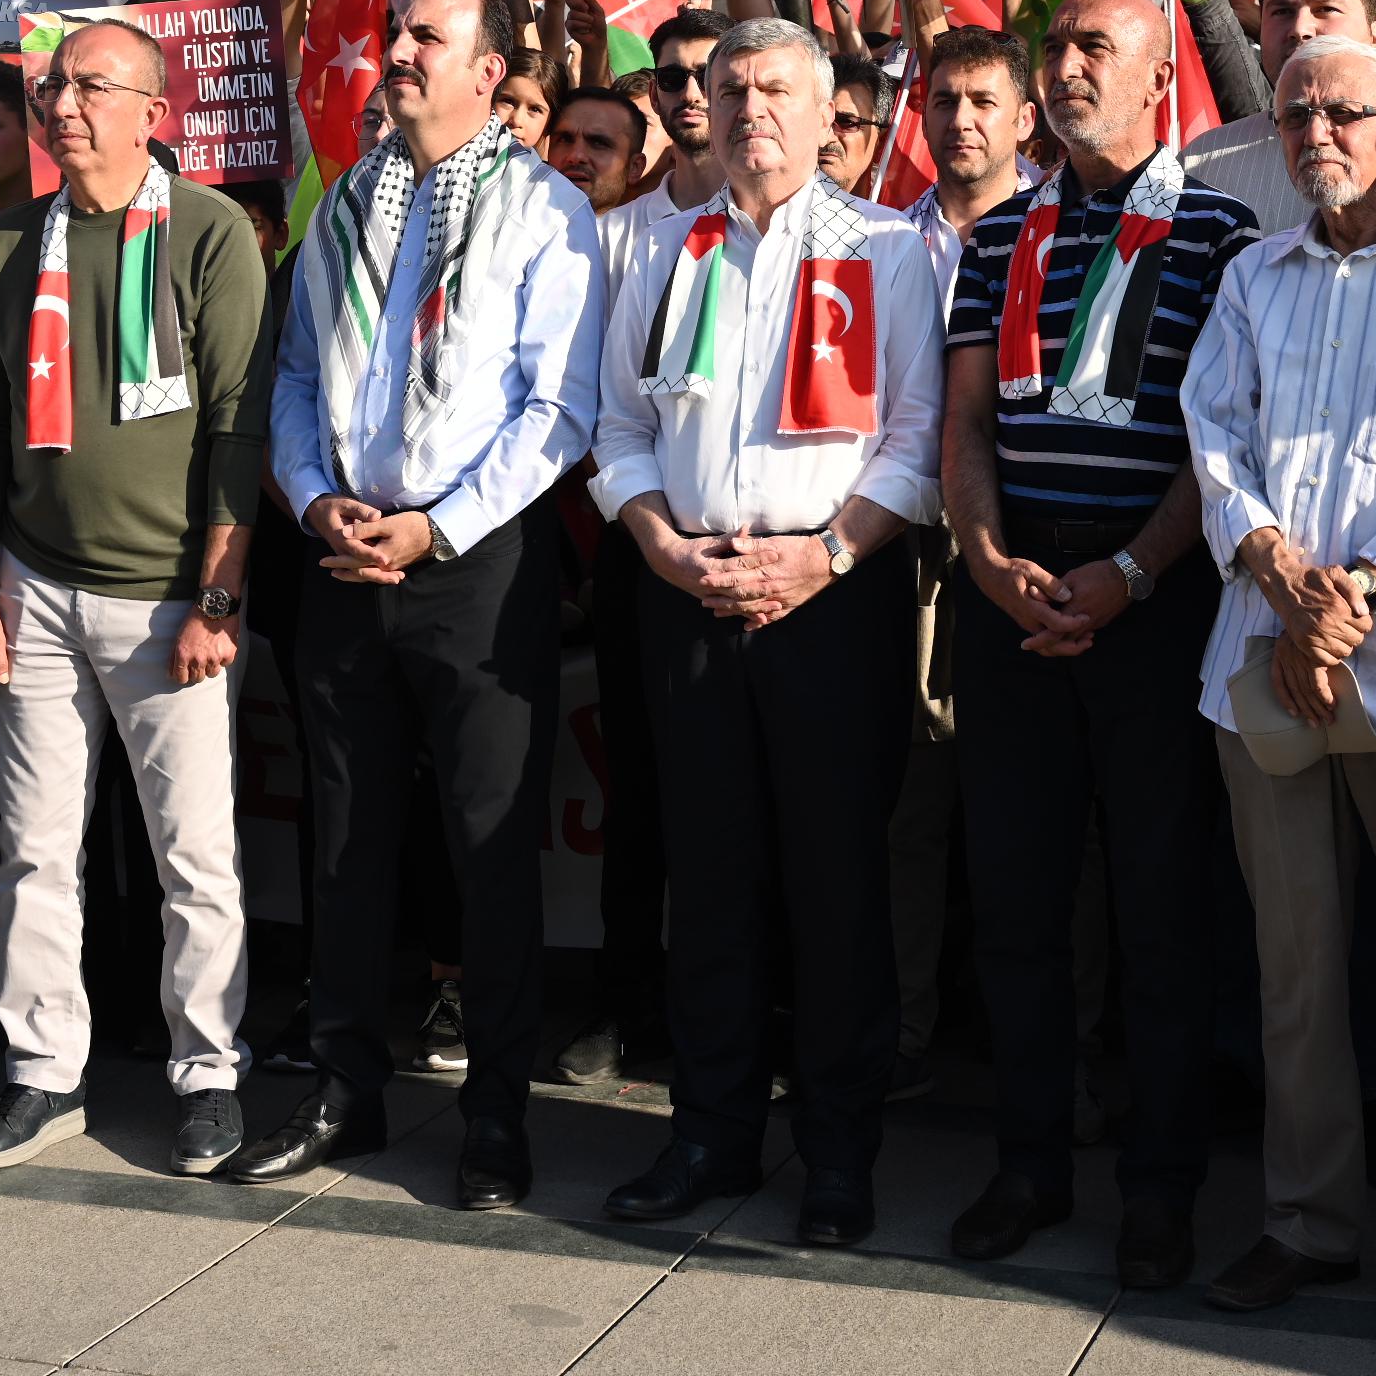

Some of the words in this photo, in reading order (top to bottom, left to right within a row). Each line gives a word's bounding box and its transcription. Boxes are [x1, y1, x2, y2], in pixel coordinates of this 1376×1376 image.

[190, 5, 269, 35] YOLUNDA,
[183, 35, 246, 70] FİLİSTİN
[251, 38, 272, 64] VE
[197, 67, 274, 103] ÜMMETİN
[183, 109, 239, 138] ONURU
[244, 100, 276, 137] İÇİN
[215, 139, 279, 170] HAZIRIZ
